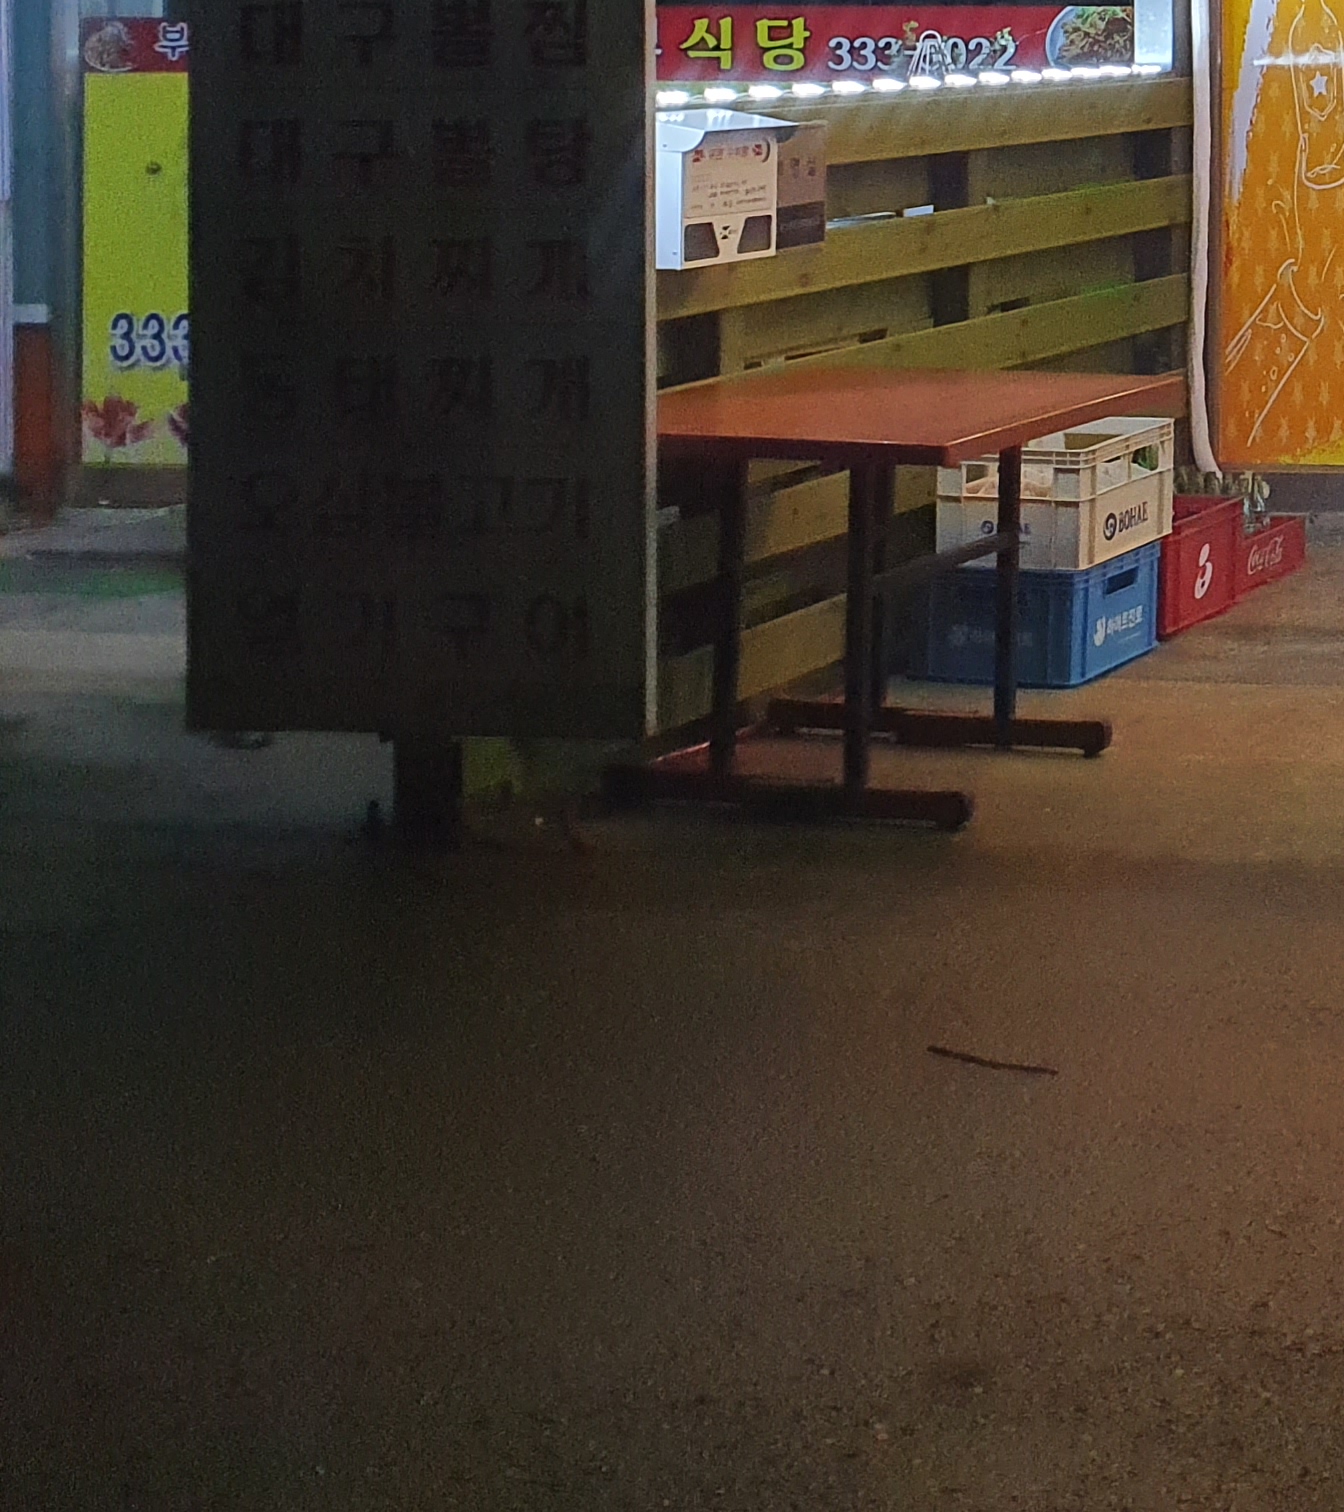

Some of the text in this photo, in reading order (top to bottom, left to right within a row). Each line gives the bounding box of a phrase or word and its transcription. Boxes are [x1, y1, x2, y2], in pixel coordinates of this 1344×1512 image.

[680, 16, 811, 73] 식당
[827, 36, 1017, 72] 333-022
[1118, 500, 1150, 536] BOHAE
